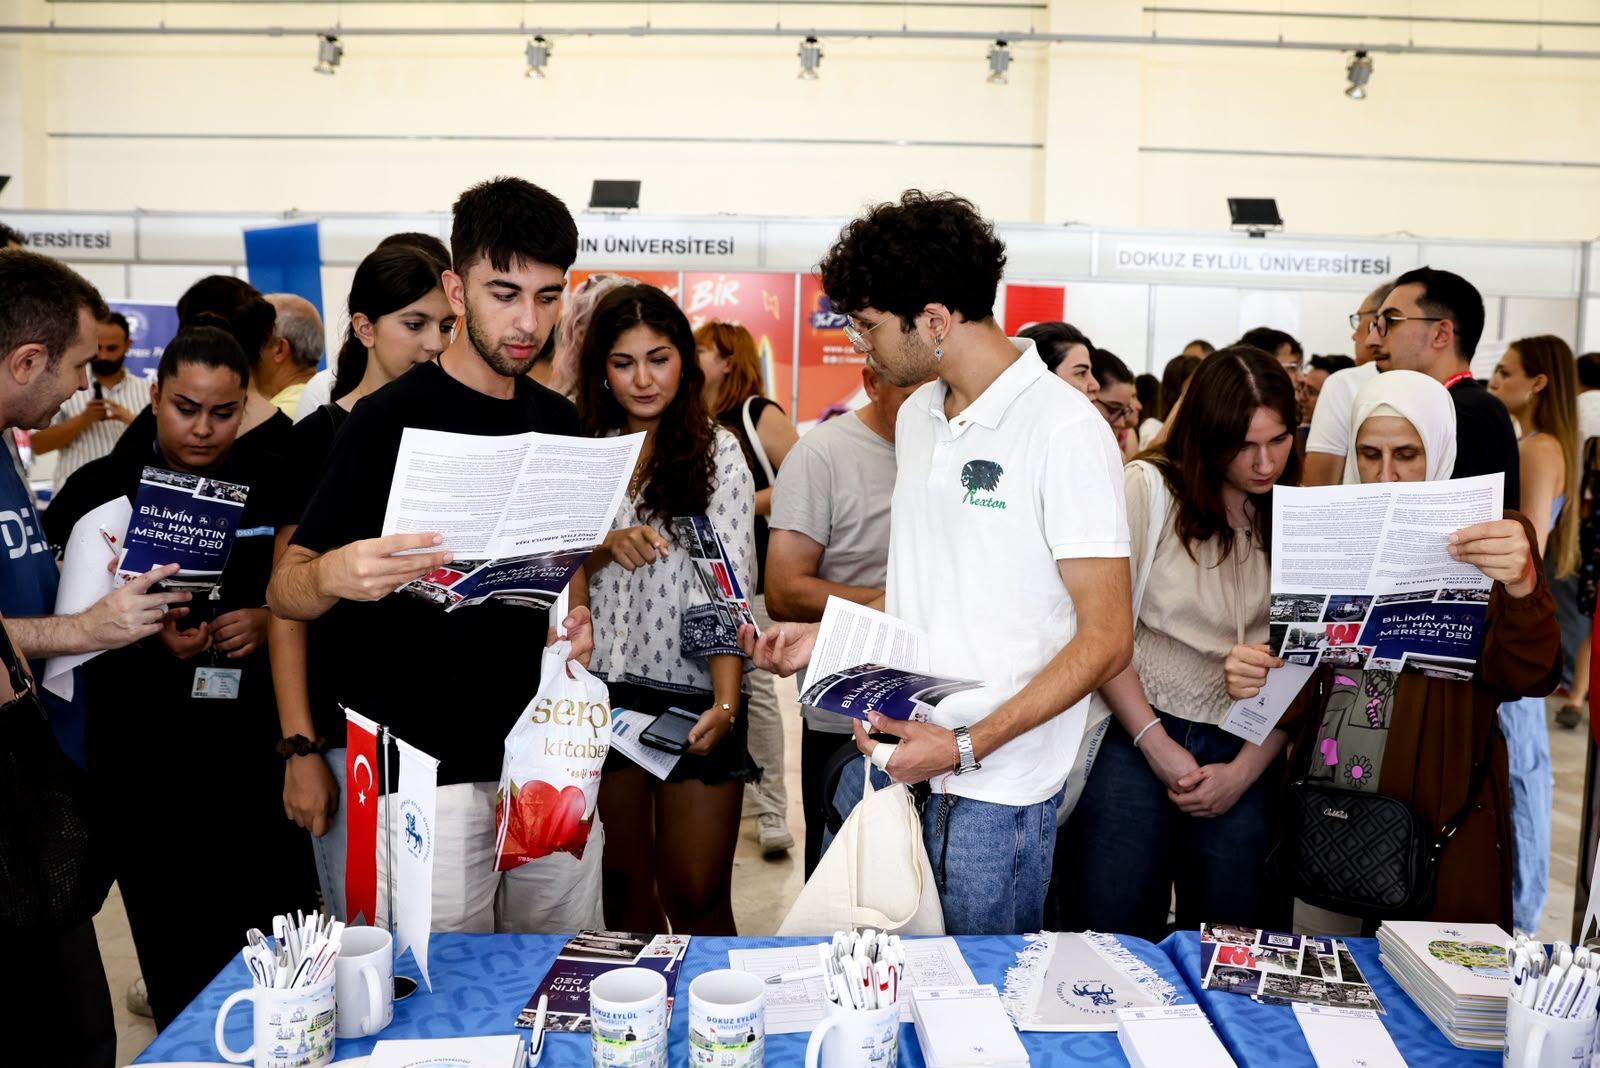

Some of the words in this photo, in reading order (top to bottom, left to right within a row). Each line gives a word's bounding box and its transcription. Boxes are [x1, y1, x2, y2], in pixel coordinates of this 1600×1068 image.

[23, 230, 111, 248] VERSİTESİ
[605, 235, 735, 255] ÜNİVERSİTESİ
[1119, 250, 1186, 268] DOKUZ
[1193, 248, 1254, 270] EYLÜL
[1260, 252, 1391, 275] ÜNİVERSİTESİ
[140, 504, 193, 524] BİLİMİN
[0, 507, 49, 560] DE
[134, 526, 196, 546] MERKEZİ
[198, 538, 224, 550] DEÜ
[152, 521, 165, 529] VE
[168, 523, 226, 540] HAYATIN
[1379, 628, 1440, 638] MERKEZİ
[1445, 631, 1472, 641] DEÜ
[1412, 621, 1473, 632] HAYATIN
[531, 697, 611, 738] serp
[613, 1012, 638, 1020] EYLÜL
[706, 1016, 734, 1025] DOKUZ
[736, 1012, 758, 1024] EYLÜL
